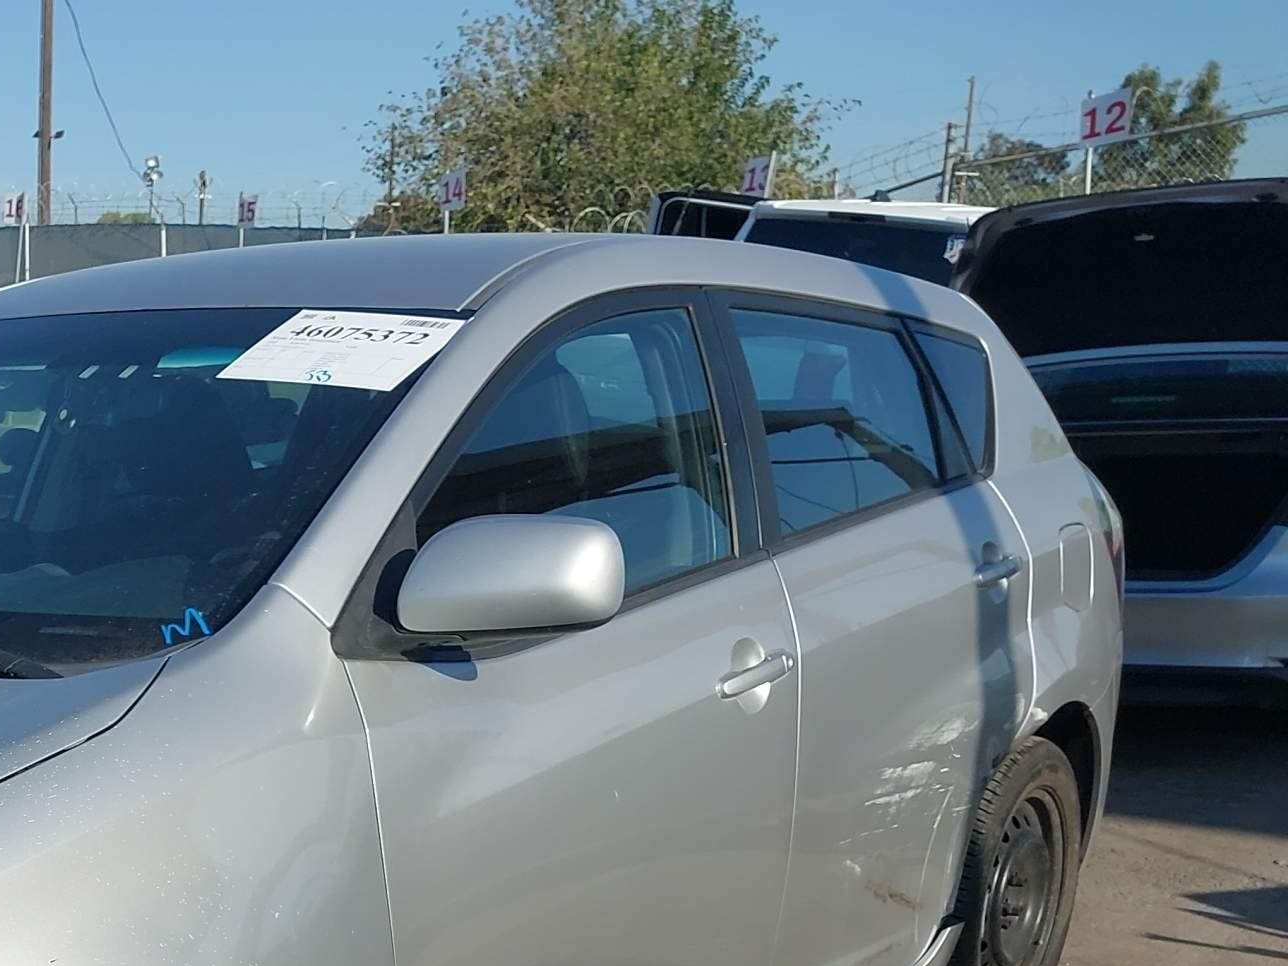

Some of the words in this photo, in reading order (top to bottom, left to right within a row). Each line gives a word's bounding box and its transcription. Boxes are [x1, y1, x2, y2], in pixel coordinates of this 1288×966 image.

[1082, 101, 1127, 140] 12
[442, 178, 463, 204] 14
[238, 202, 256, 222] 15
[290, 324, 430, 345] 46075372
